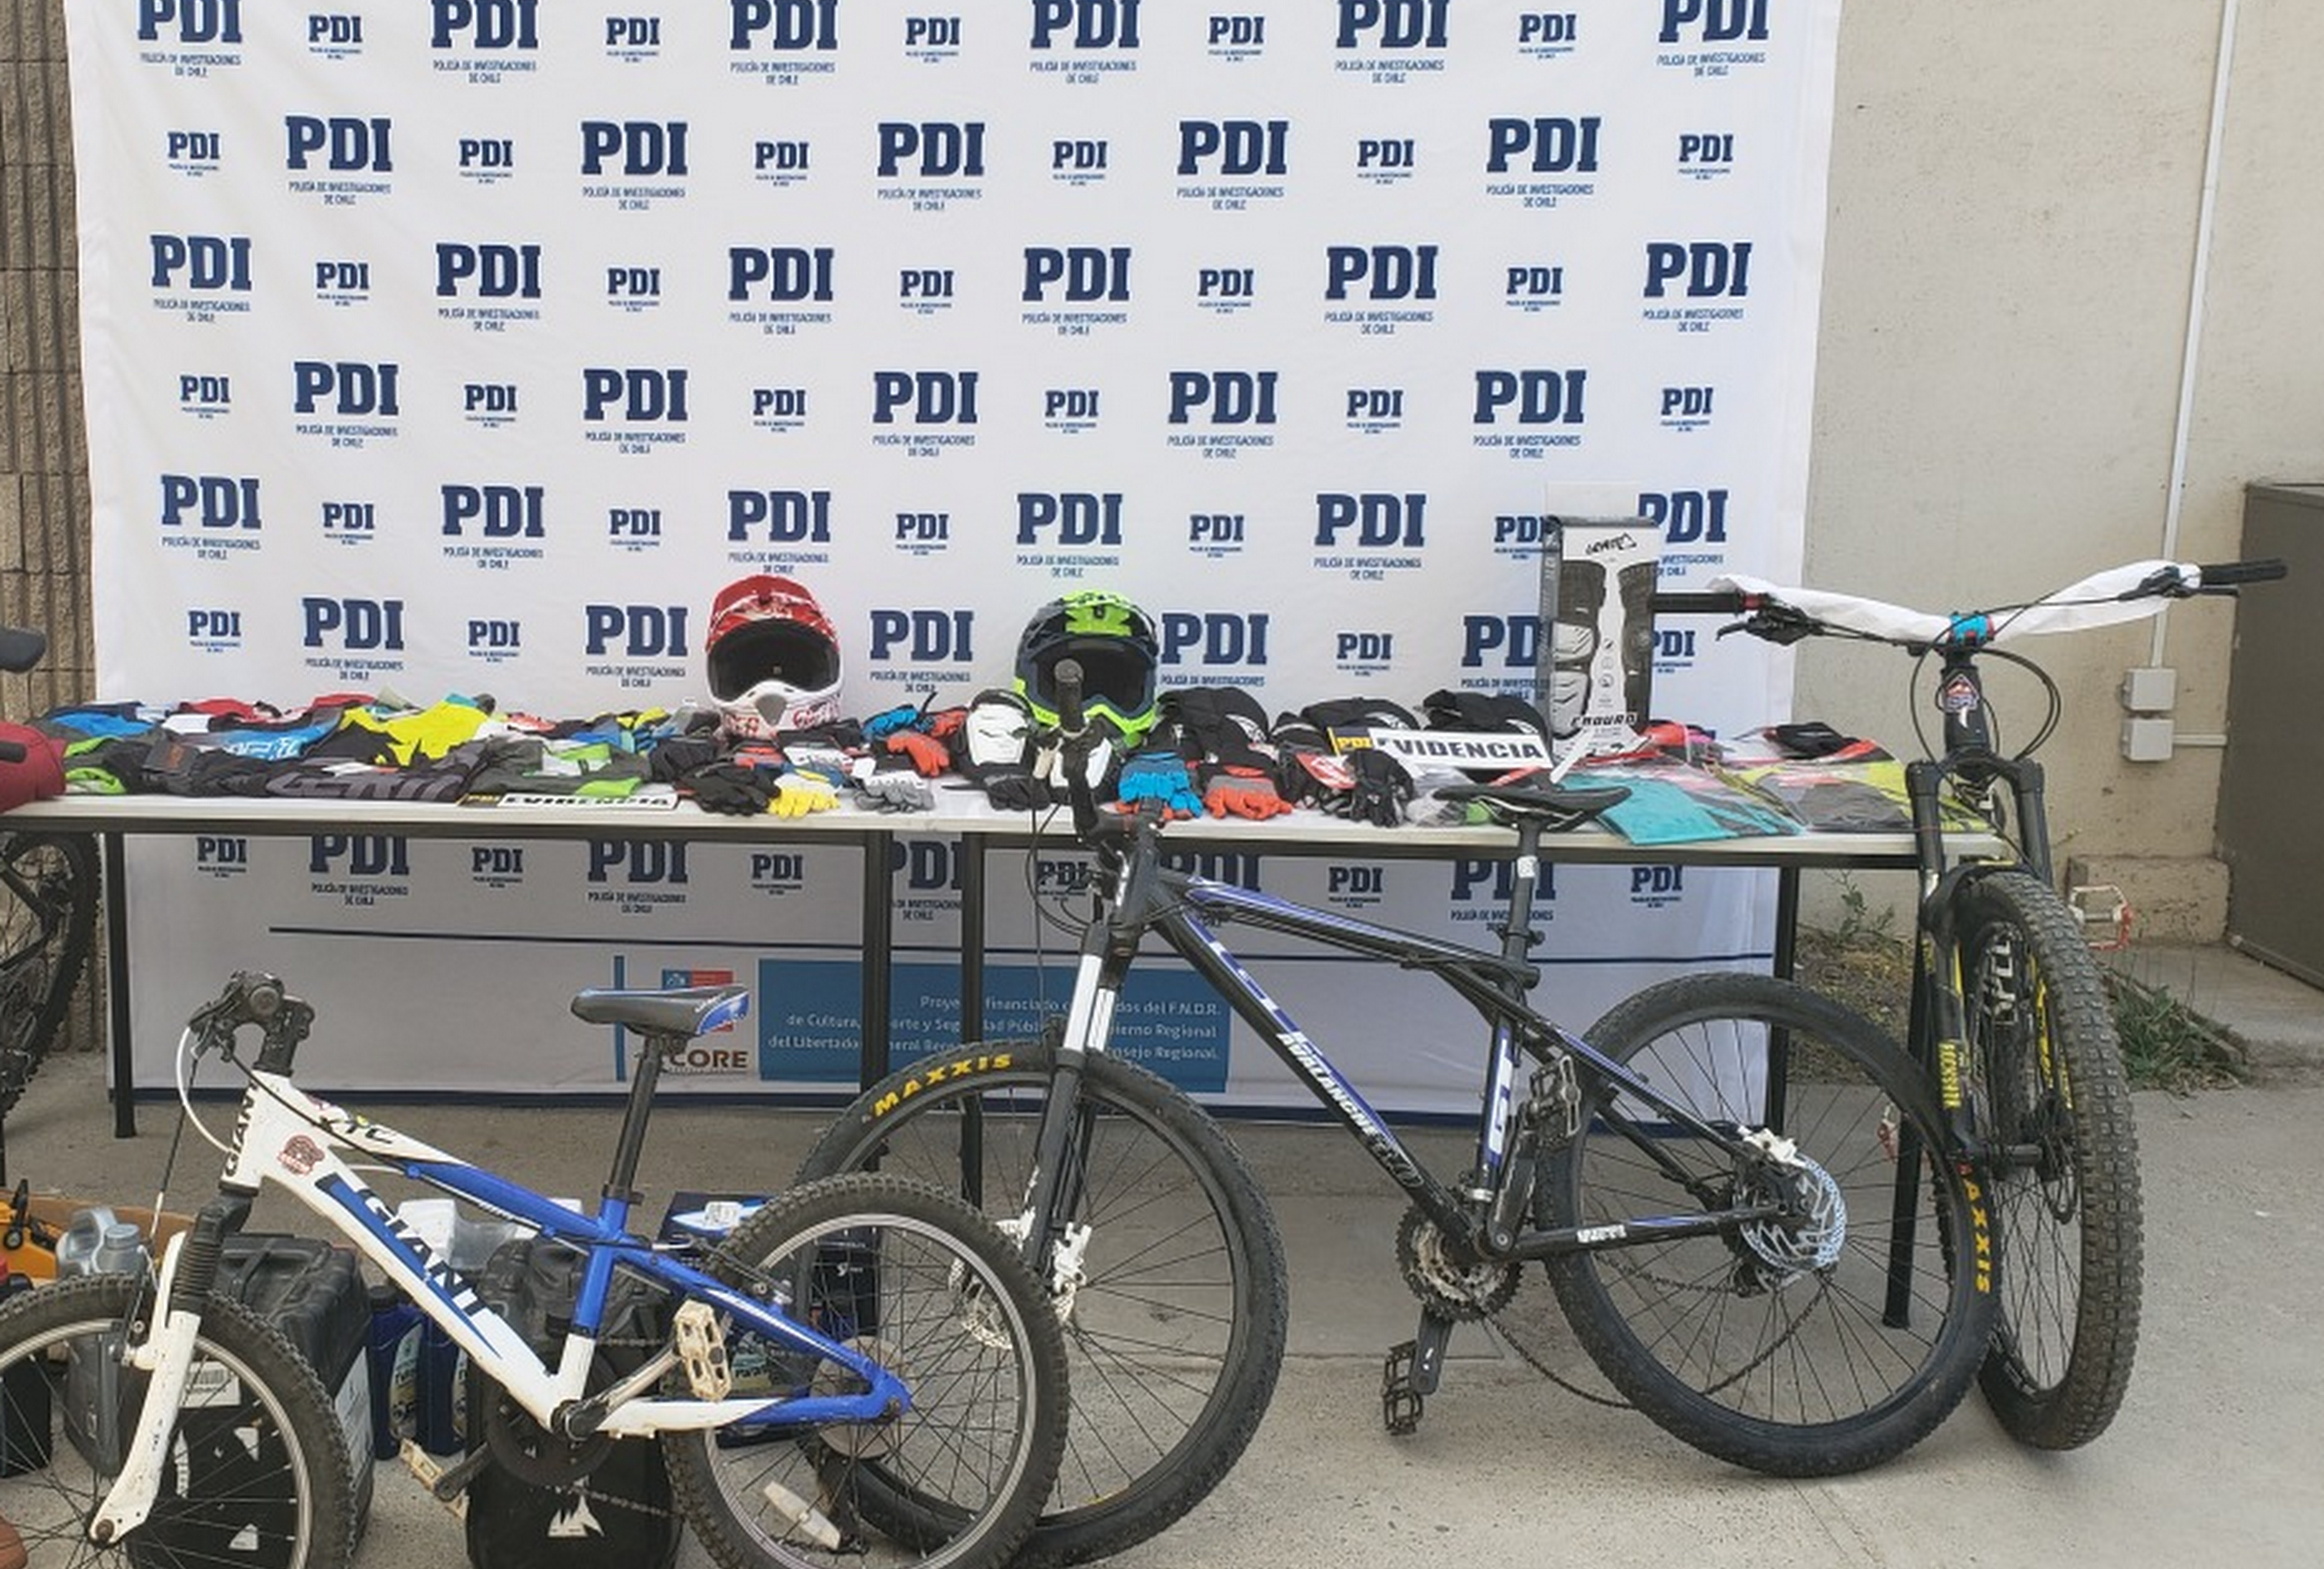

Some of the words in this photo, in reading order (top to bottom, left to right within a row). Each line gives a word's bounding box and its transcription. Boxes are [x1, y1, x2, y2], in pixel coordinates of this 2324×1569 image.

[138, 0, 242, 43] PDI
[309, 15, 362, 43] PDI
[431, 0, 538, 49] PDI
[606, 18, 660, 45] PDI
[730, 0, 837, 49] PDI
[906, 18, 960, 45] PDI
[1031, 0, 1140, 49] PDI
[1209, 17, 1264, 44] PDI
[1336, 0, 1449, 48] PDI
[1519, 14, 1576, 42] PDI
[1659, 0, 1768, 43] PDI
[168, 132, 219, 159] PDI
[286, 116, 392, 172] PDI
[459, 140, 512, 167] PDI
[581, 122, 687, 175] PDI
[756, 142, 808, 169] PDI
[878, 123, 985, 177] PDI
[1053, 141, 1107, 168] PDI
[1177, 121, 1288, 175] PDI
[1358, 140, 1414, 167] PDI
[1487, 117, 1600, 173] PDI
[1679, 135, 1733, 162] PDI
[151, 235, 251, 291] PDI
[316, 262, 369, 290] PDI
[436, 243, 541, 298] PDI
[729, 248, 834, 301] PDI
[1023, 248, 1131, 301] PDI
[1325, 246, 1438, 300] PDI
[1644, 243, 1752, 297] PDI
[608, 268, 660, 296] PDI
[901, 271, 954, 297] PDI
[1198, 269, 1254, 296] PDI
[1507, 267, 1562, 295] PDI
[180, 375, 230, 403] PDI
[294, 362, 399, 415] PDI
[465, 385, 517, 411] PDI
[584, 369, 687, 421] PDI
[753, 390, 805, 415] PDI
[873, 372, 978, 424] PDI
[1169, 372, 1278, 424] PDI
[1474, 370, 1586, 424] PDI
[1661, 388, 1713, 415] PDI
[1045, 391, 1098, 417] PDI
[1347, 390, 1403, 417] PDI
[161, 475, 261, 529] PDI
[322, 503, 374, 529] PDI
[442, 485, 544, 537] PDI
[610, 509, 660, 535] PDI
[729, 491, 830, 542] PDI
[896, 514, 949, 539] PDI
[1017, 493, 1123, 545] PDI
[1190, 515, 1244, 541] PDI
[1315, 494, 1426, 547] PDI
[189, 611, 241, 636] PDI
[302, 598, 404, 651] PDI
[469, 621, 520, 646] PDI
[586, 606, 688, 656] PDI
[870, 610, 974, 661] PDI
[1161, 613, 1269, 665] PDI
[1337, 633, 1393, 660] PDI
[1461, 615, 1541, 667] PD
[1337, 737, 1372, 749] PDI
[1379, 738, 1543, 759] VIDENCIA
[197, 837, 247, 863] PDI
[310, 835, 409, 875] PDI
[473, 848, 523, 873] PDI
[588, 839, 688, 882] PDI
[752, 855, 803, 880] PDI
[1329, 867, 1382, 893] PDI
[1632, 866, 1683, 893] PDI
[1143, 1002, 1166, 1014] del
[786, 1014, 804, 1025] de
[922, 1020, 932, 1032] y
[1156, 1023, 1216, 1039] Regional
[768, 1036, 790, 1048] del
[793, 1036, 859, 1048] Libertado
[669, 1049, 748, 1068] CORE
[874, 1053, 1013, 1117] MAXXIS
[1963, 1179, 1992, 1294] AXXIS
